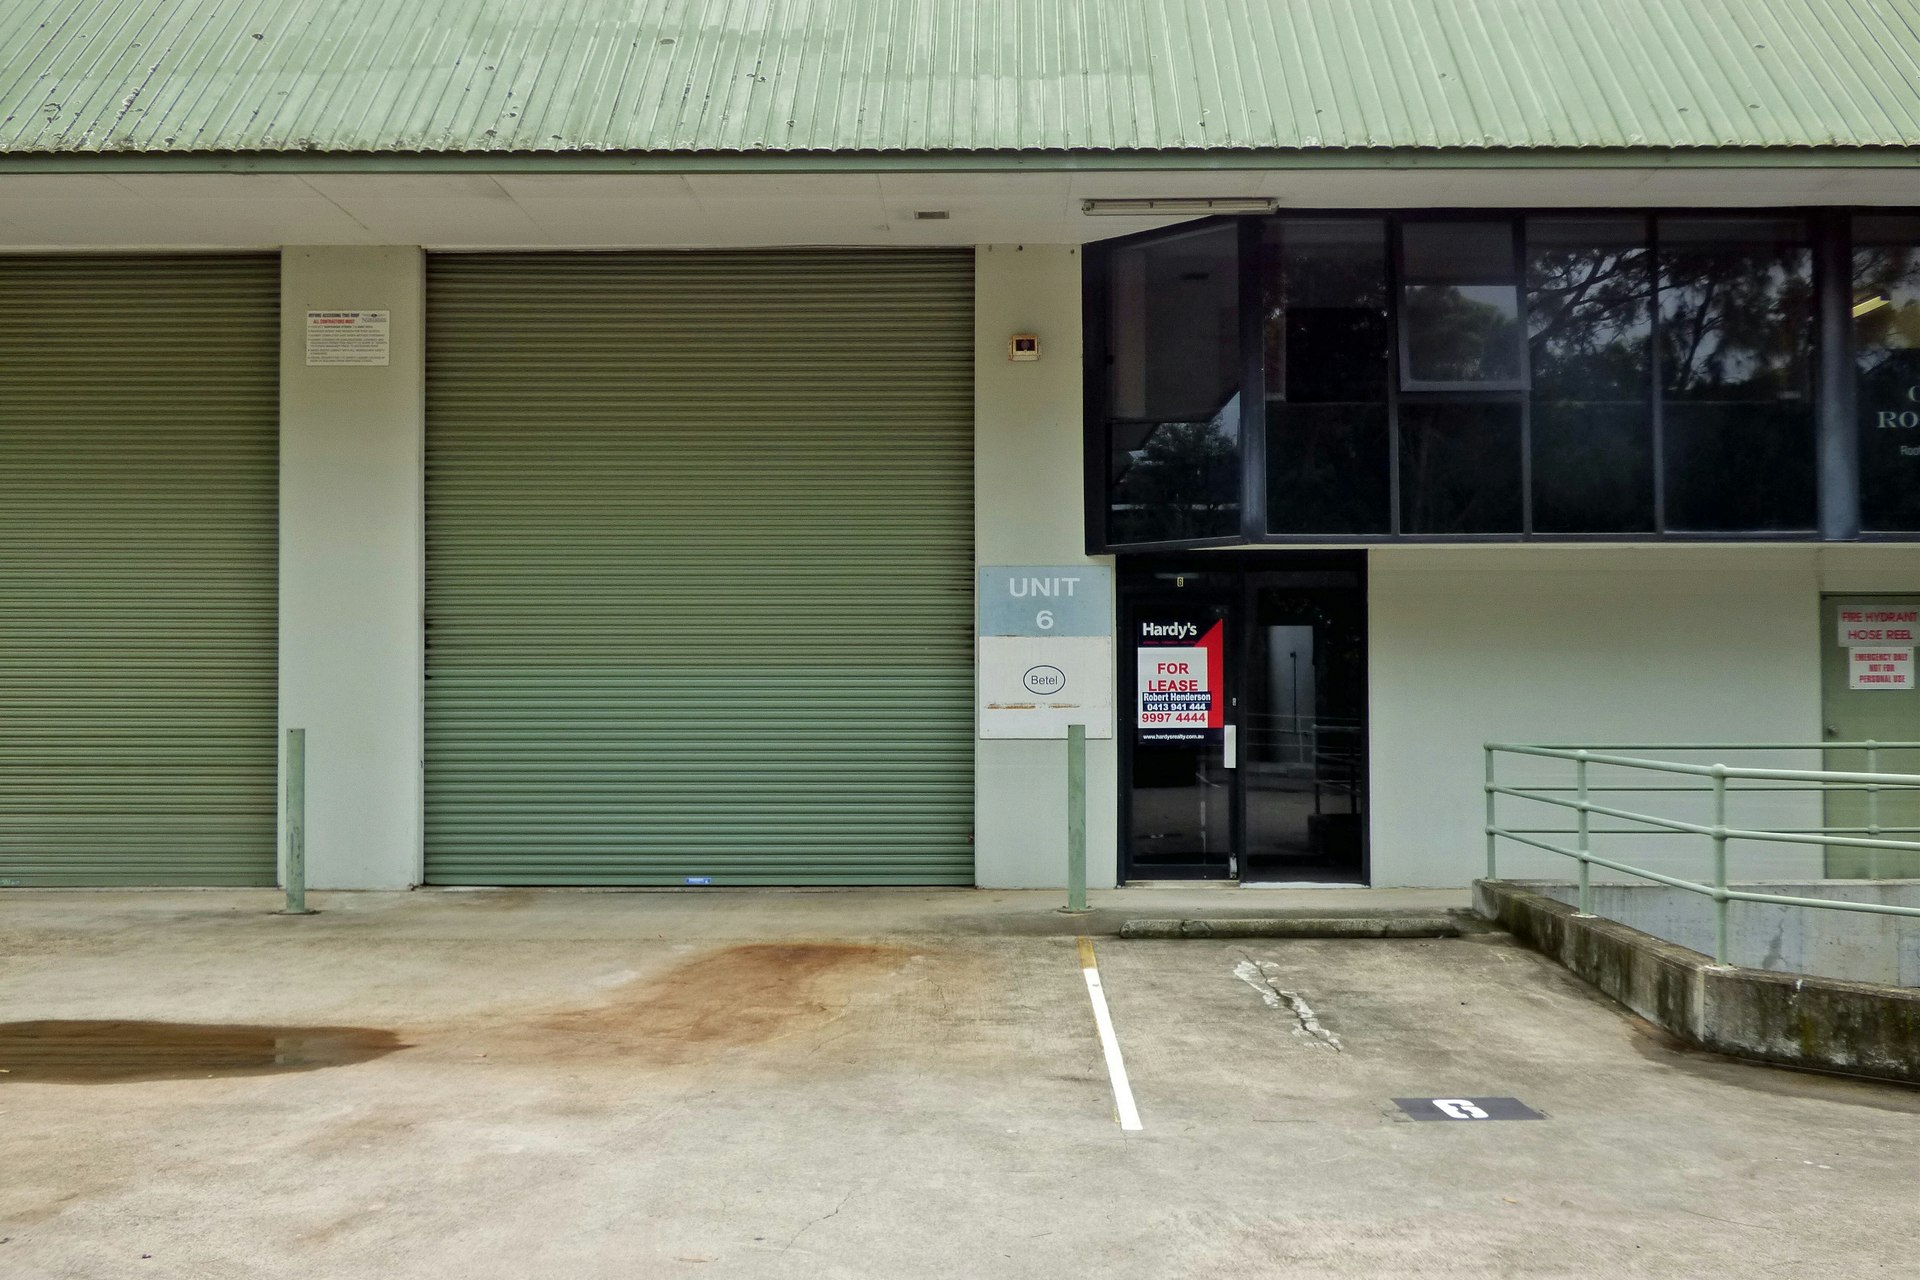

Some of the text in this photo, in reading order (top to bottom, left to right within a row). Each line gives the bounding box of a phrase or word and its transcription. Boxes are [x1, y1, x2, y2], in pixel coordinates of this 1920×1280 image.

[1877, 411, 1920, 428] RO
[1900, 445, 1920, 456] Roo
[1009, 577, 1080, 597] UNIT
[1036, 610, 1054, 630] 6
[1841, 611, 1918, 622] FIRE HYDRANT
[1142, 622, 1198, 639] Hardy's
[1848, 630, 1913, 640] HOSE REEL
[1855, 653, 1891, 661] EMERGENCY
[1157, 662, 1189, 675] FOR
[1869, 664, 1895, 672] NOT FOR
[1030, 675, 1058, 686] Betel
[1859, 675, 1906, 683] PERSONAL USE
[1148, 680, 1199, 692] LEASE
[1143, 692, 1211, 702] Robert Henderson
[1147, 703, 1206, 711] 0413 941 444
[1142, 713, 1206, 723] 9997 4444
[1143, 733, 1205, 741] www.hardysrealty.com.au
